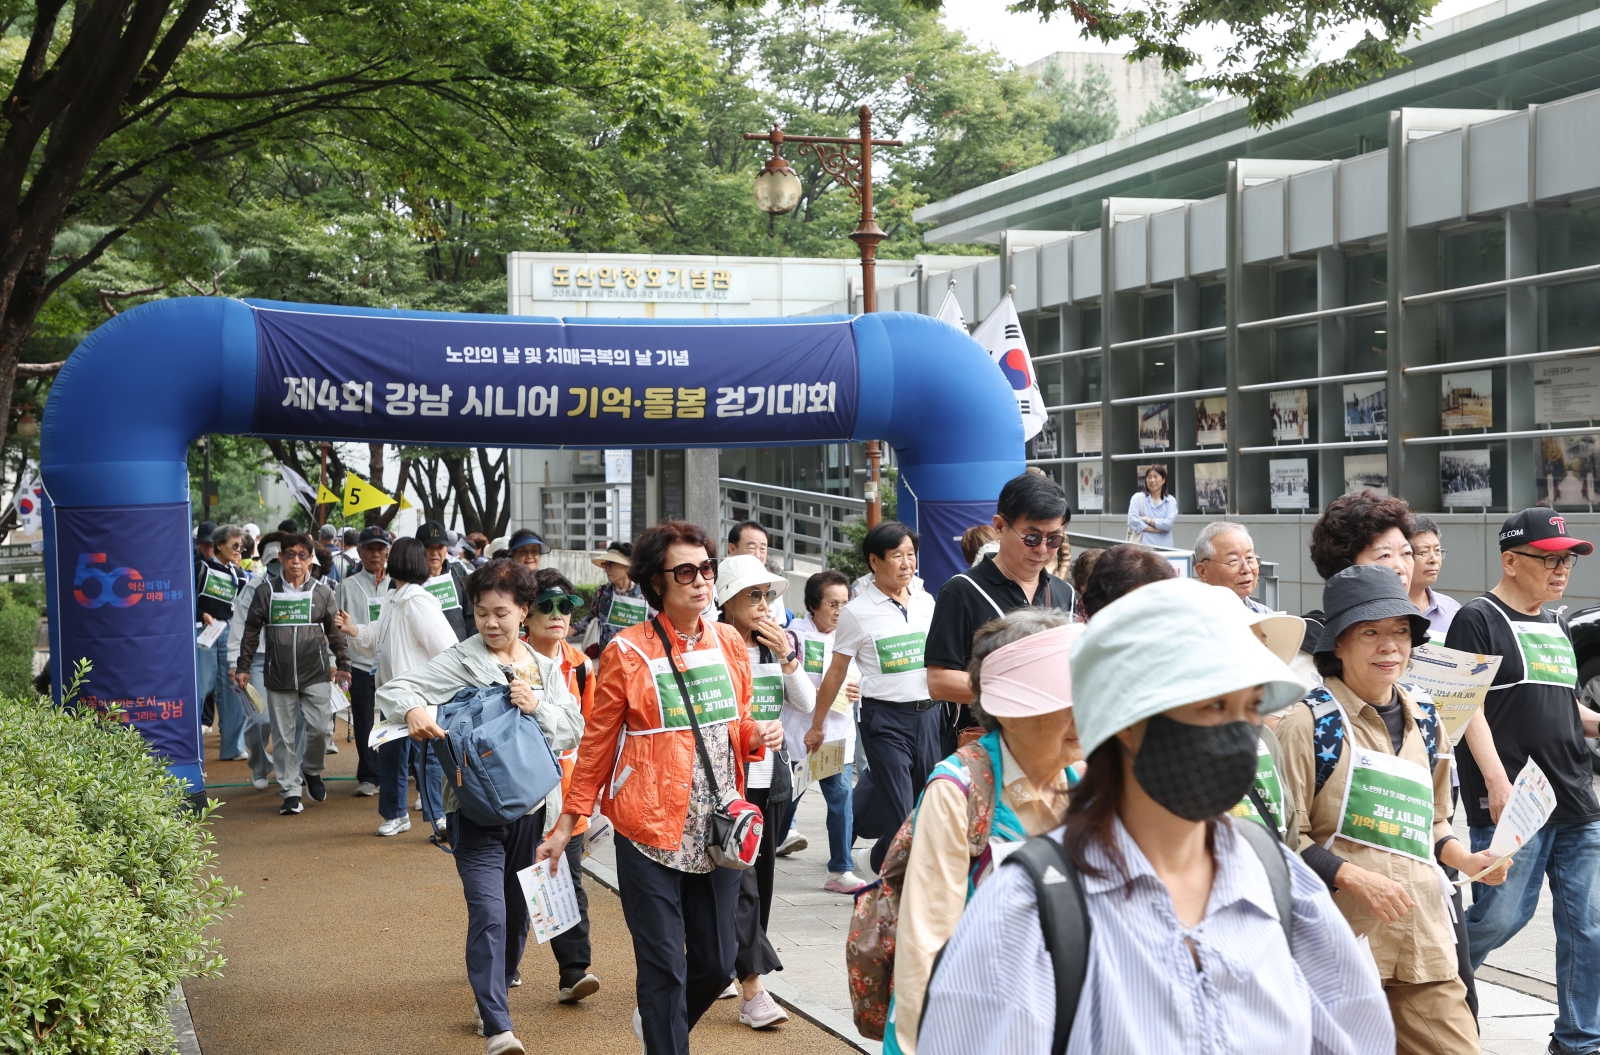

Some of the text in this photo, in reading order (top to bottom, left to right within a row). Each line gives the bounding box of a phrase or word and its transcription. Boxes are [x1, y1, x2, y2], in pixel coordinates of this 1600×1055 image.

[552, 266, 732, 290] 도산안창호기념관
[705, 291, 728, 300] HALL
[446, 346, 690, 367] 노인의 날 및 치매극복의 날 기념
[281, 376, 837, 419] 제4회 강남 시니어 기억·돌봄 걷기대회
[349, 487, 361, 505] 5
[128, 580, 171, 592] 혁신의 강남
[146, 592, 170, 602] 미래의
[135, 695, 156, 708] 도시
[697, 688, 722, 702] 시니어
[131, 711, 158, 722] 그리는
[157, 699, 184, 720] 강남
[1372, 803, 1426, 828] 강남 시니어
